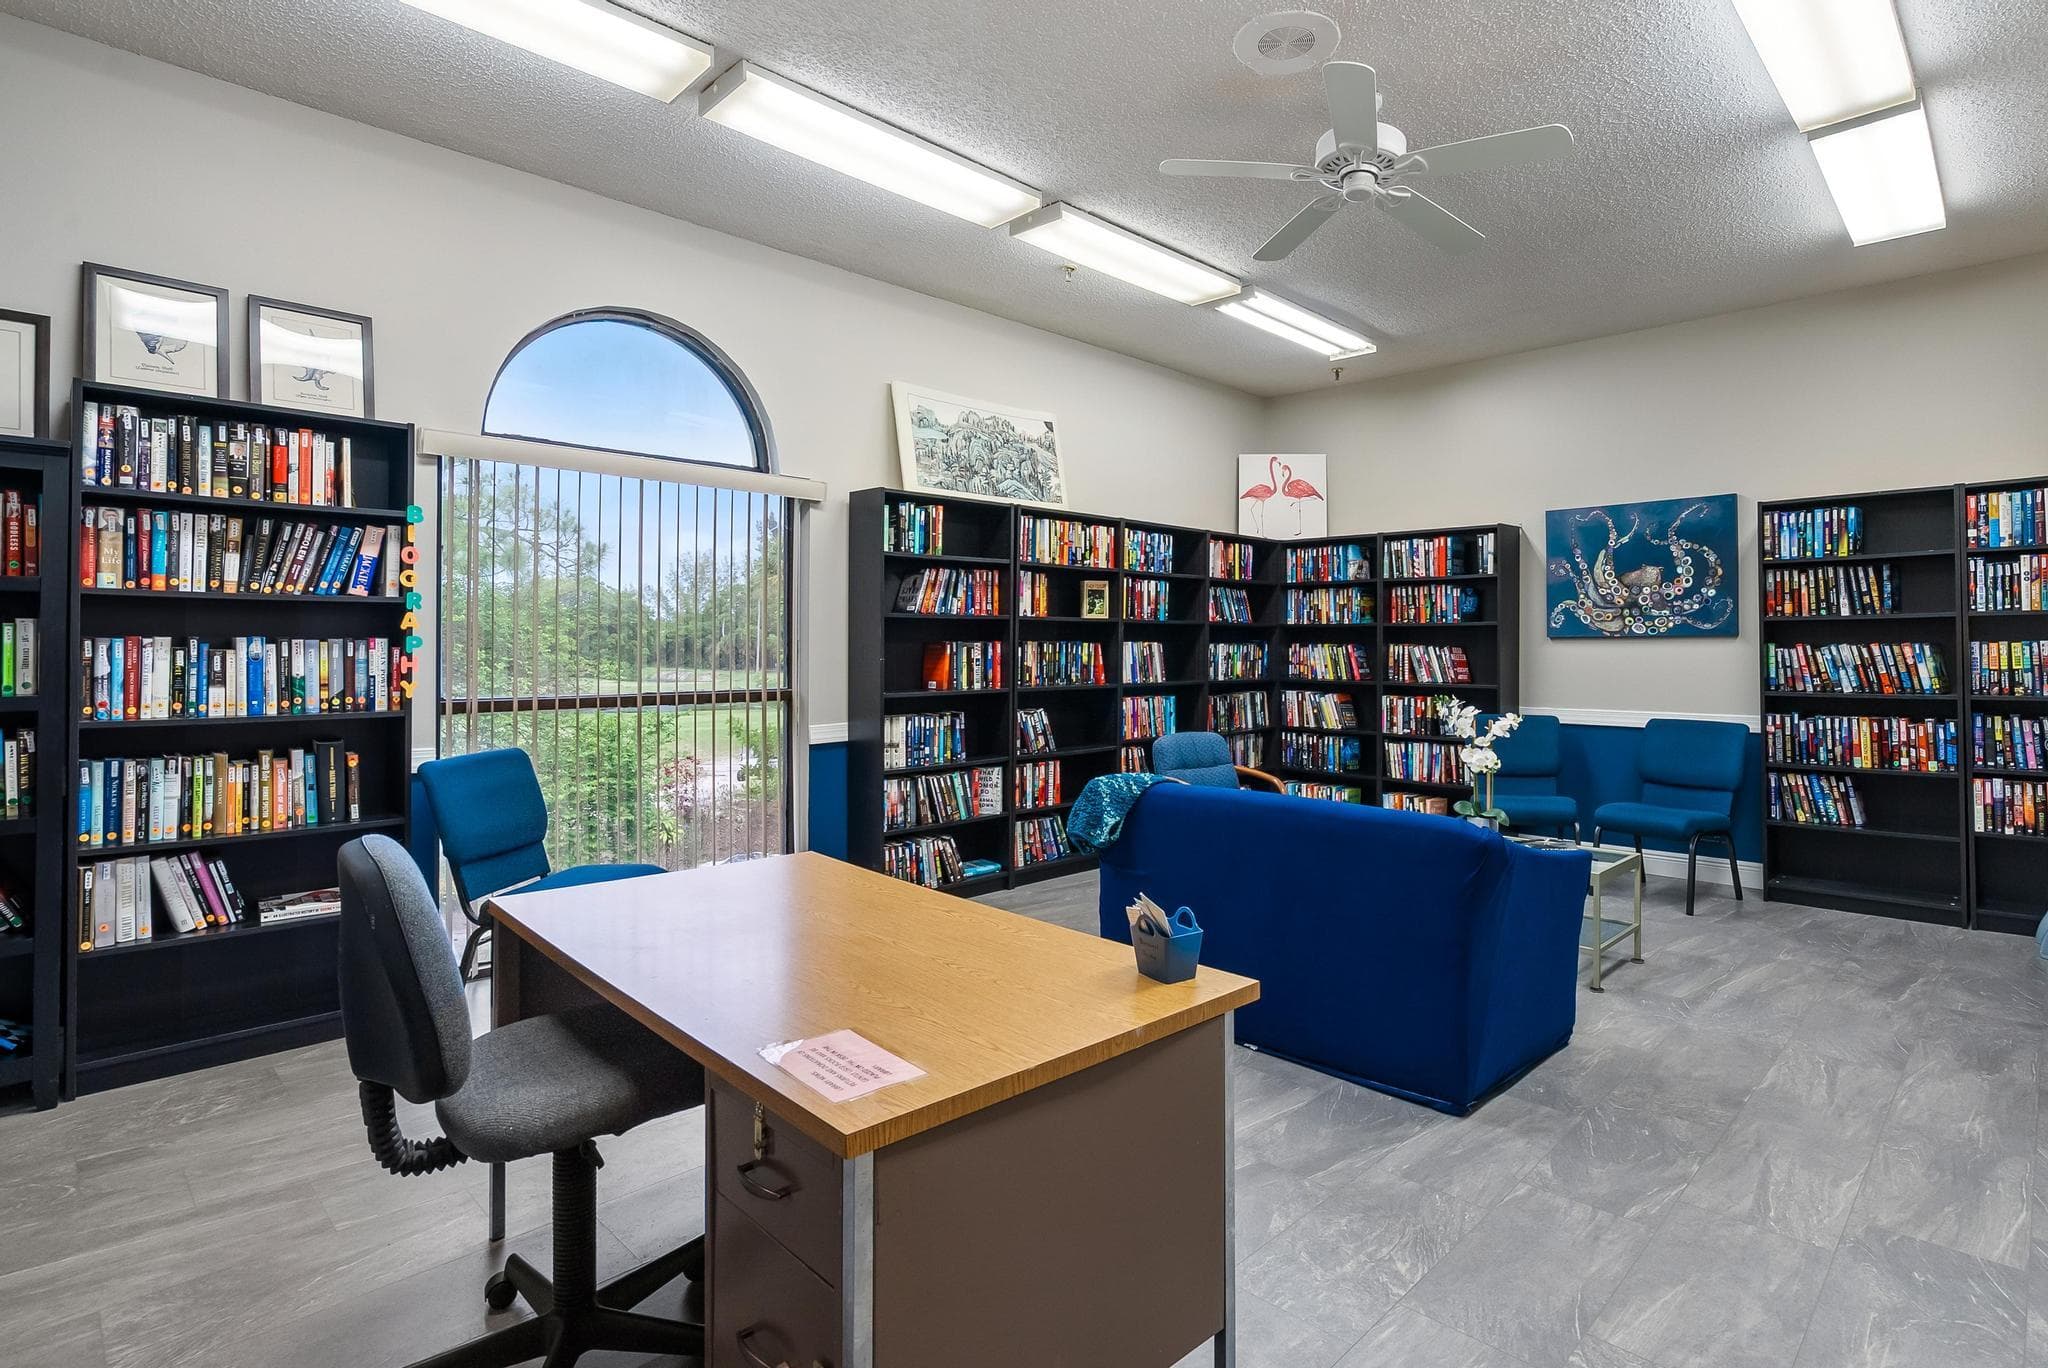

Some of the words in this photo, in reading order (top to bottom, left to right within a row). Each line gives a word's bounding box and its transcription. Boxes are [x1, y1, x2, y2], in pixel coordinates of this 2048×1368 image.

[253, 460, 262, 475] BUSH
[10, 521, 19, 551] GODLESS
[102, 557, 121, 565] Life
[104, 548, 119, 559] My
[255, 542, 267, 569] FONDA
[358, 554, 374, 586] JACKIE
[399, 504, 424, 699] BIOGRAPHY
[111, 779, 119, 807] NICKLAUS
